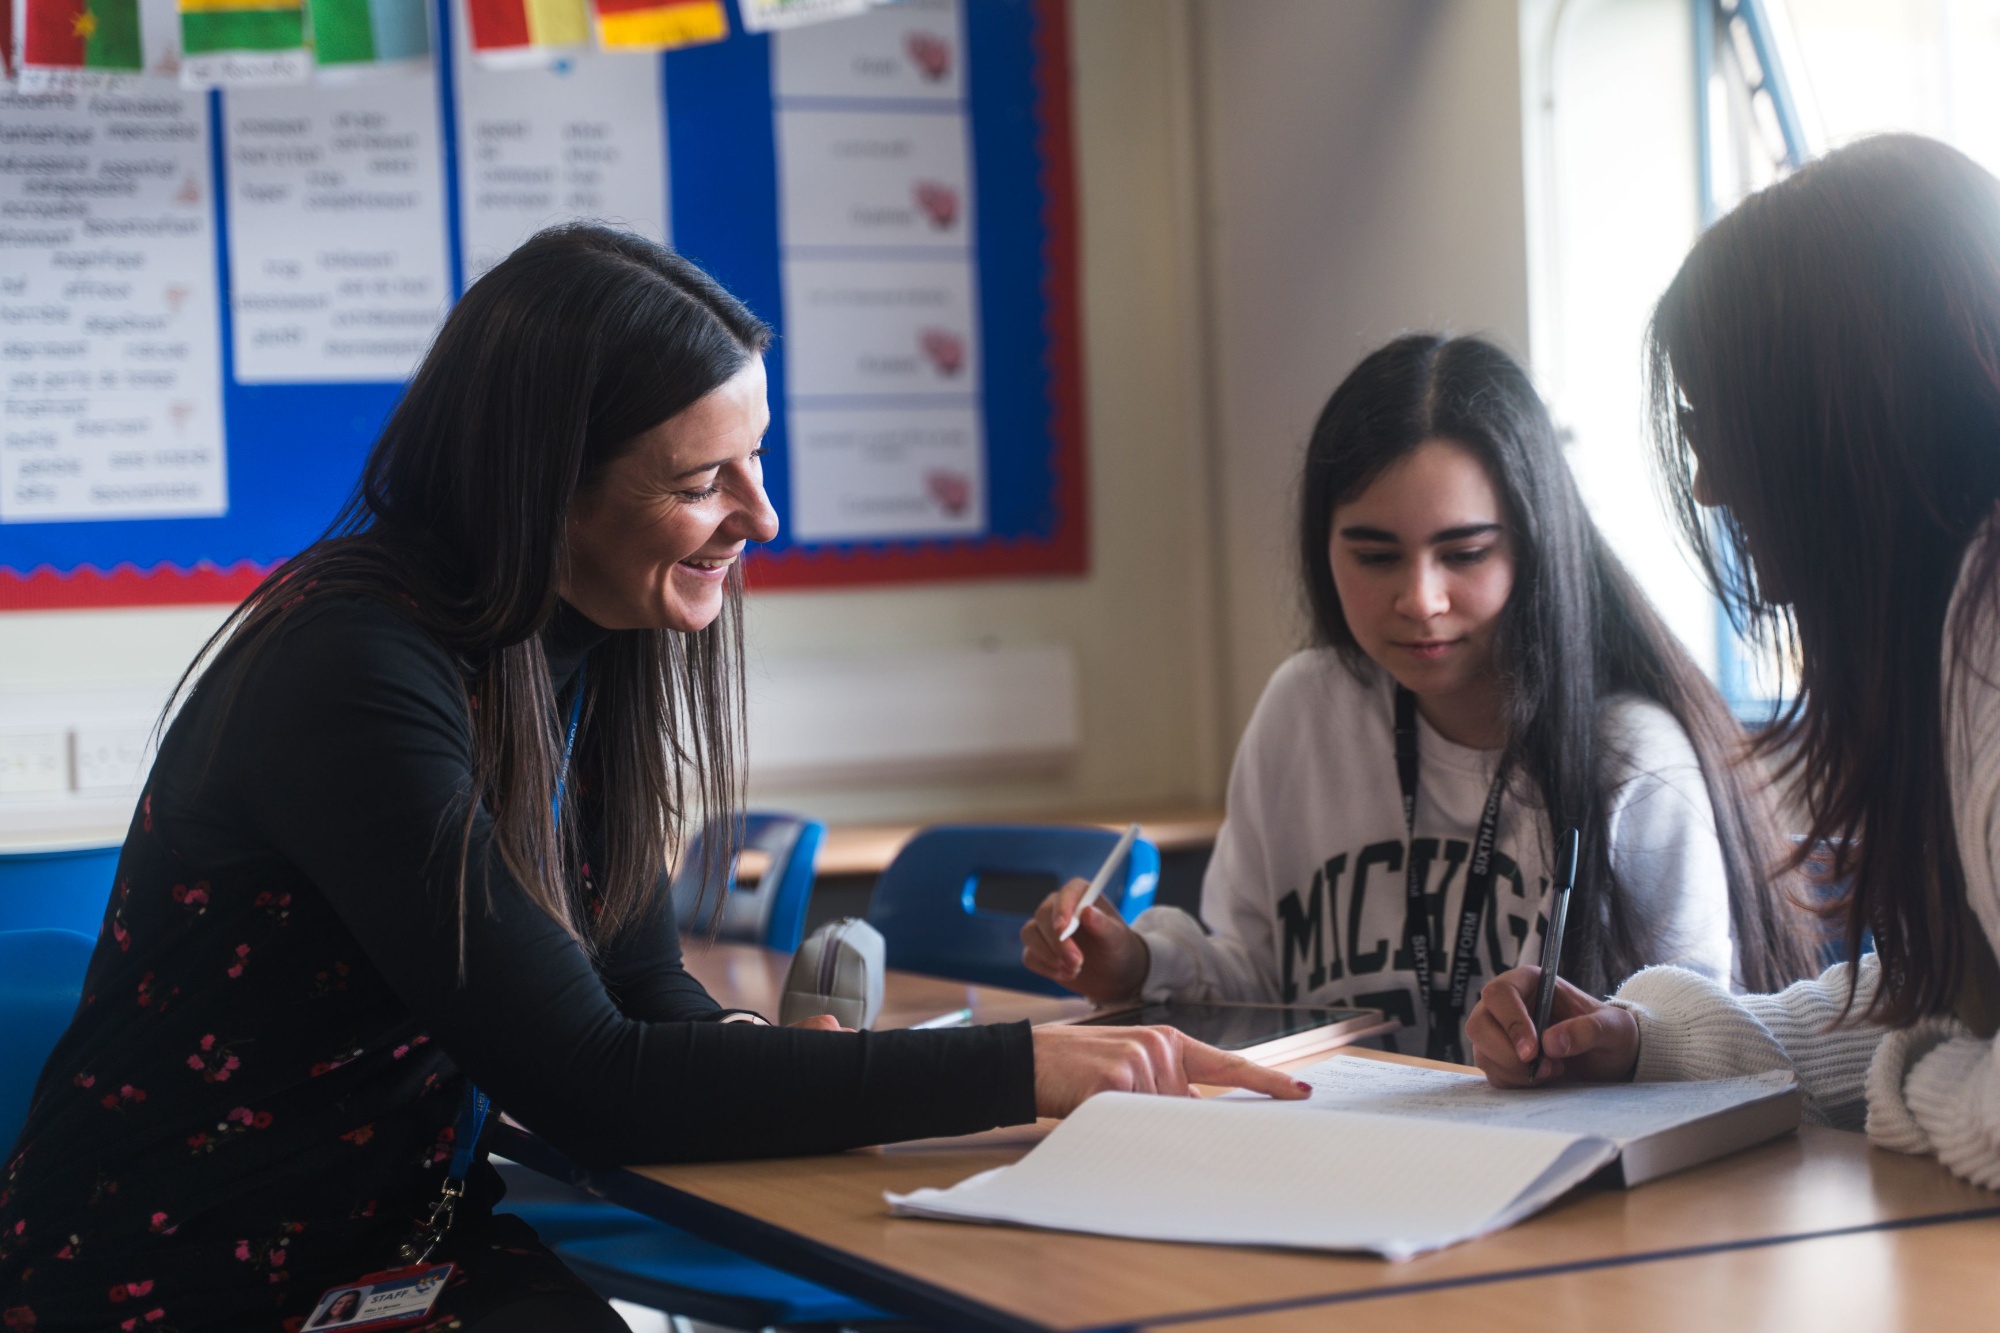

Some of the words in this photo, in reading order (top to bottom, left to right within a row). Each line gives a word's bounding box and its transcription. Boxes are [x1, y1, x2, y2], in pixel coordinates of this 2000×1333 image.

[1472, 826, 1494, 875] SIXTH
[1458, 911, 1480, 959] FORM
[1451, 961, 1470, 1008] SIXTH
[371, 1289, 410, 1304] STAFF
